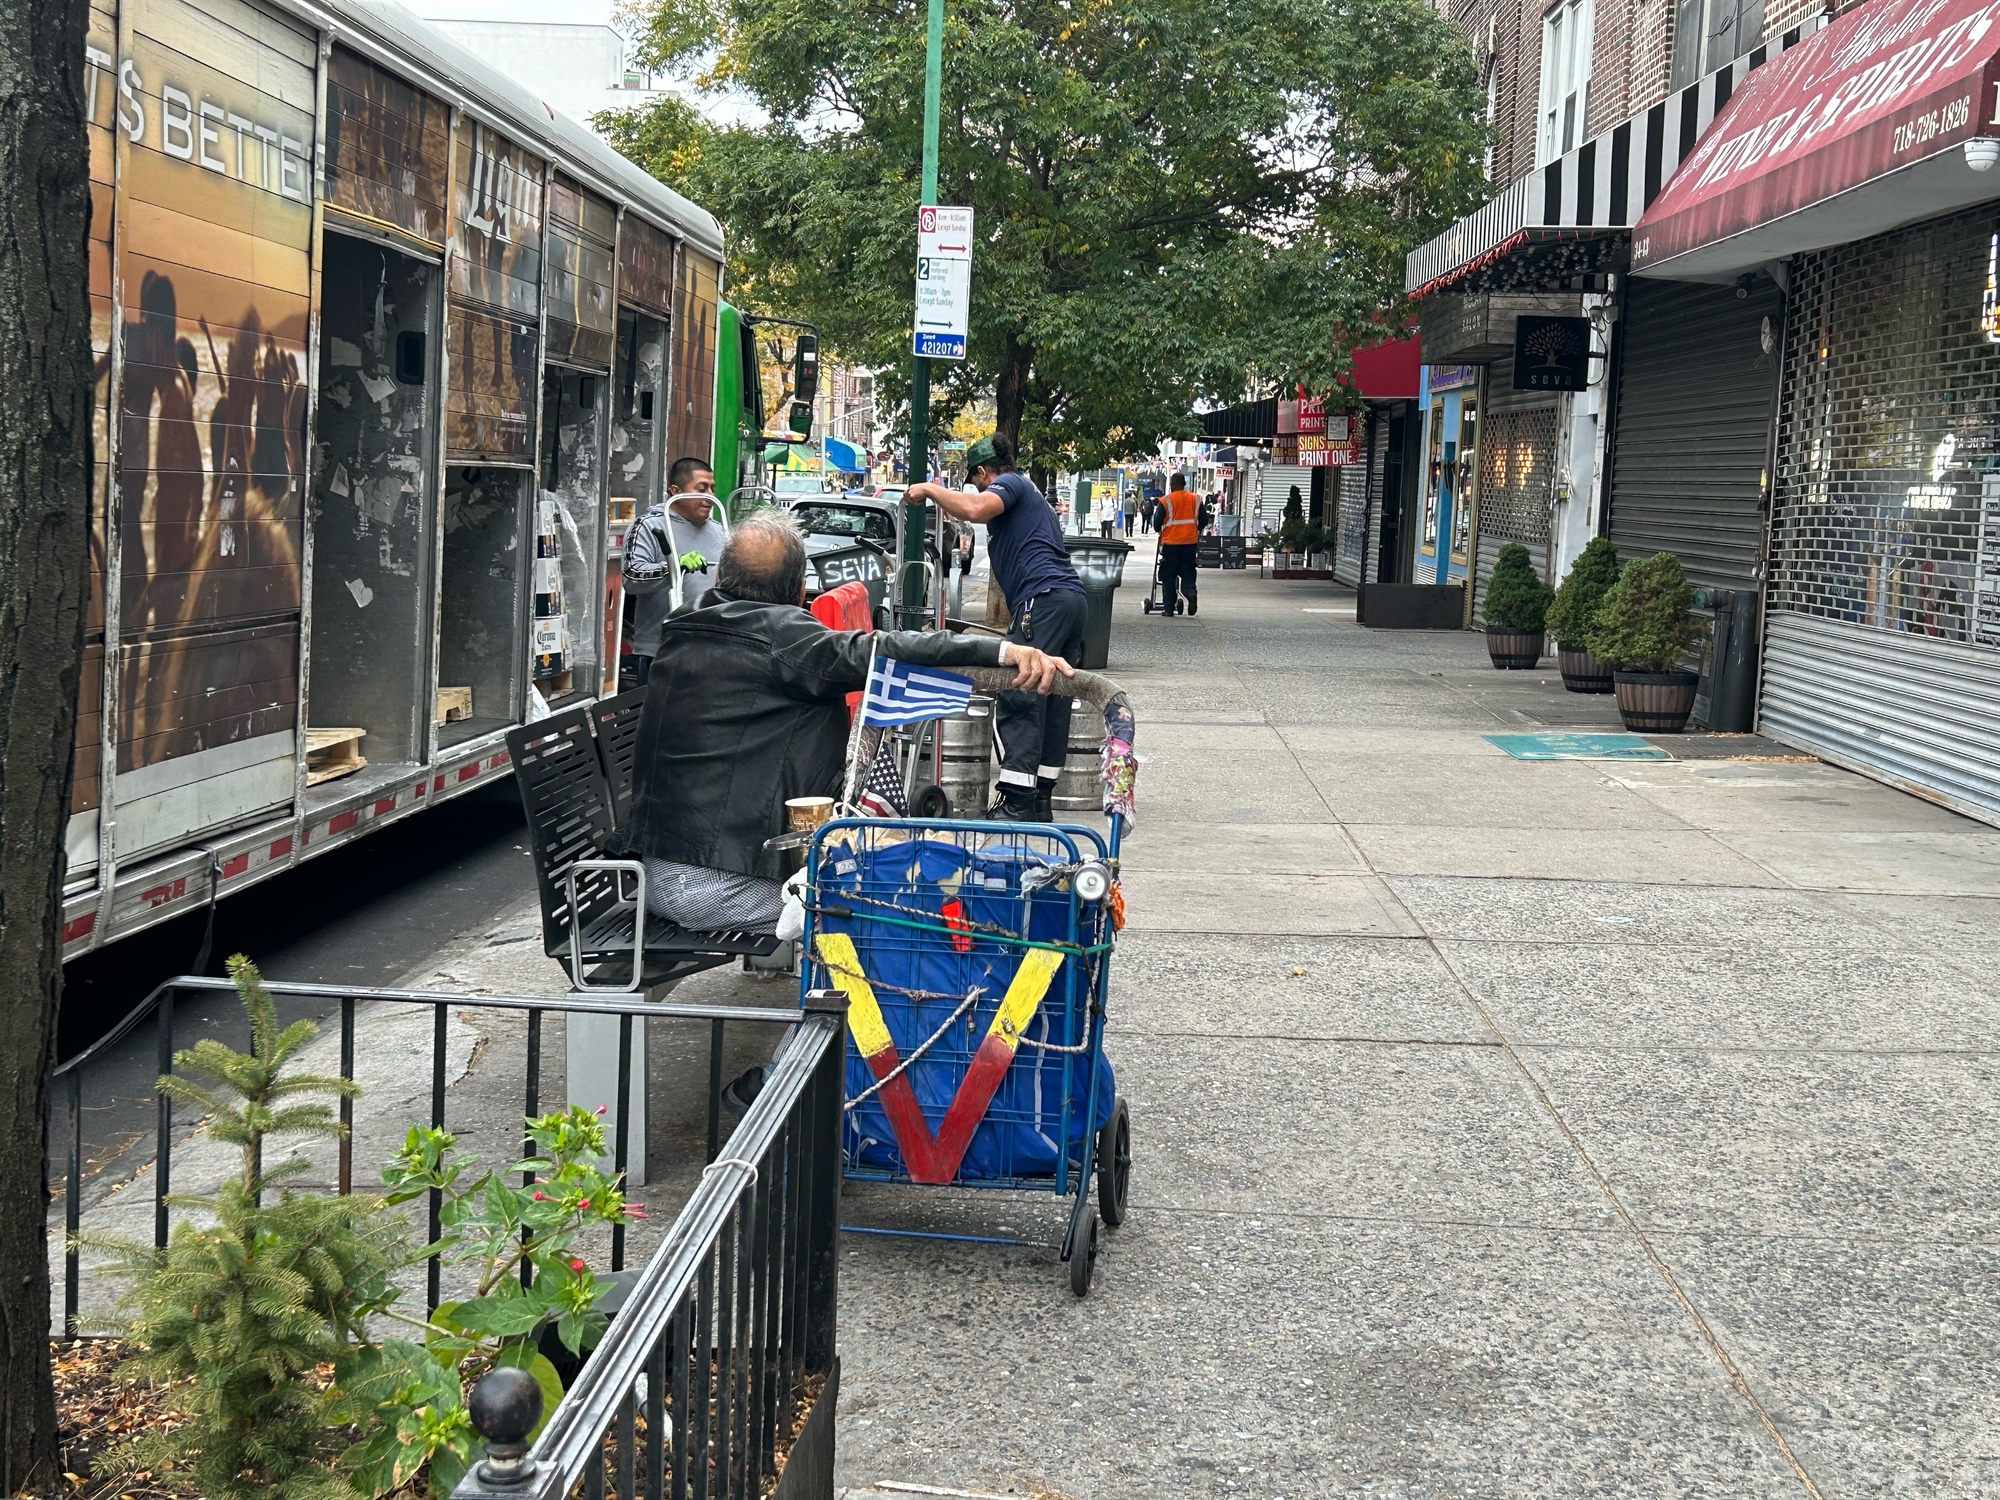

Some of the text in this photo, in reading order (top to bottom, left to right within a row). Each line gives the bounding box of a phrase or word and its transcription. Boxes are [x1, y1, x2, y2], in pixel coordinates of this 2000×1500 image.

[1893, 95, 1970, 154] 718-726-1826
[920, 259, 929, 279] 2
[936, 298, 953, 308] Sunday
[921, 341, 952, 355] 421207
[1299, 435, 1325, 451] SIGNS
[1299, 450, 1330, 466] PRINT
[824, 554, 881, 583] SEVA
